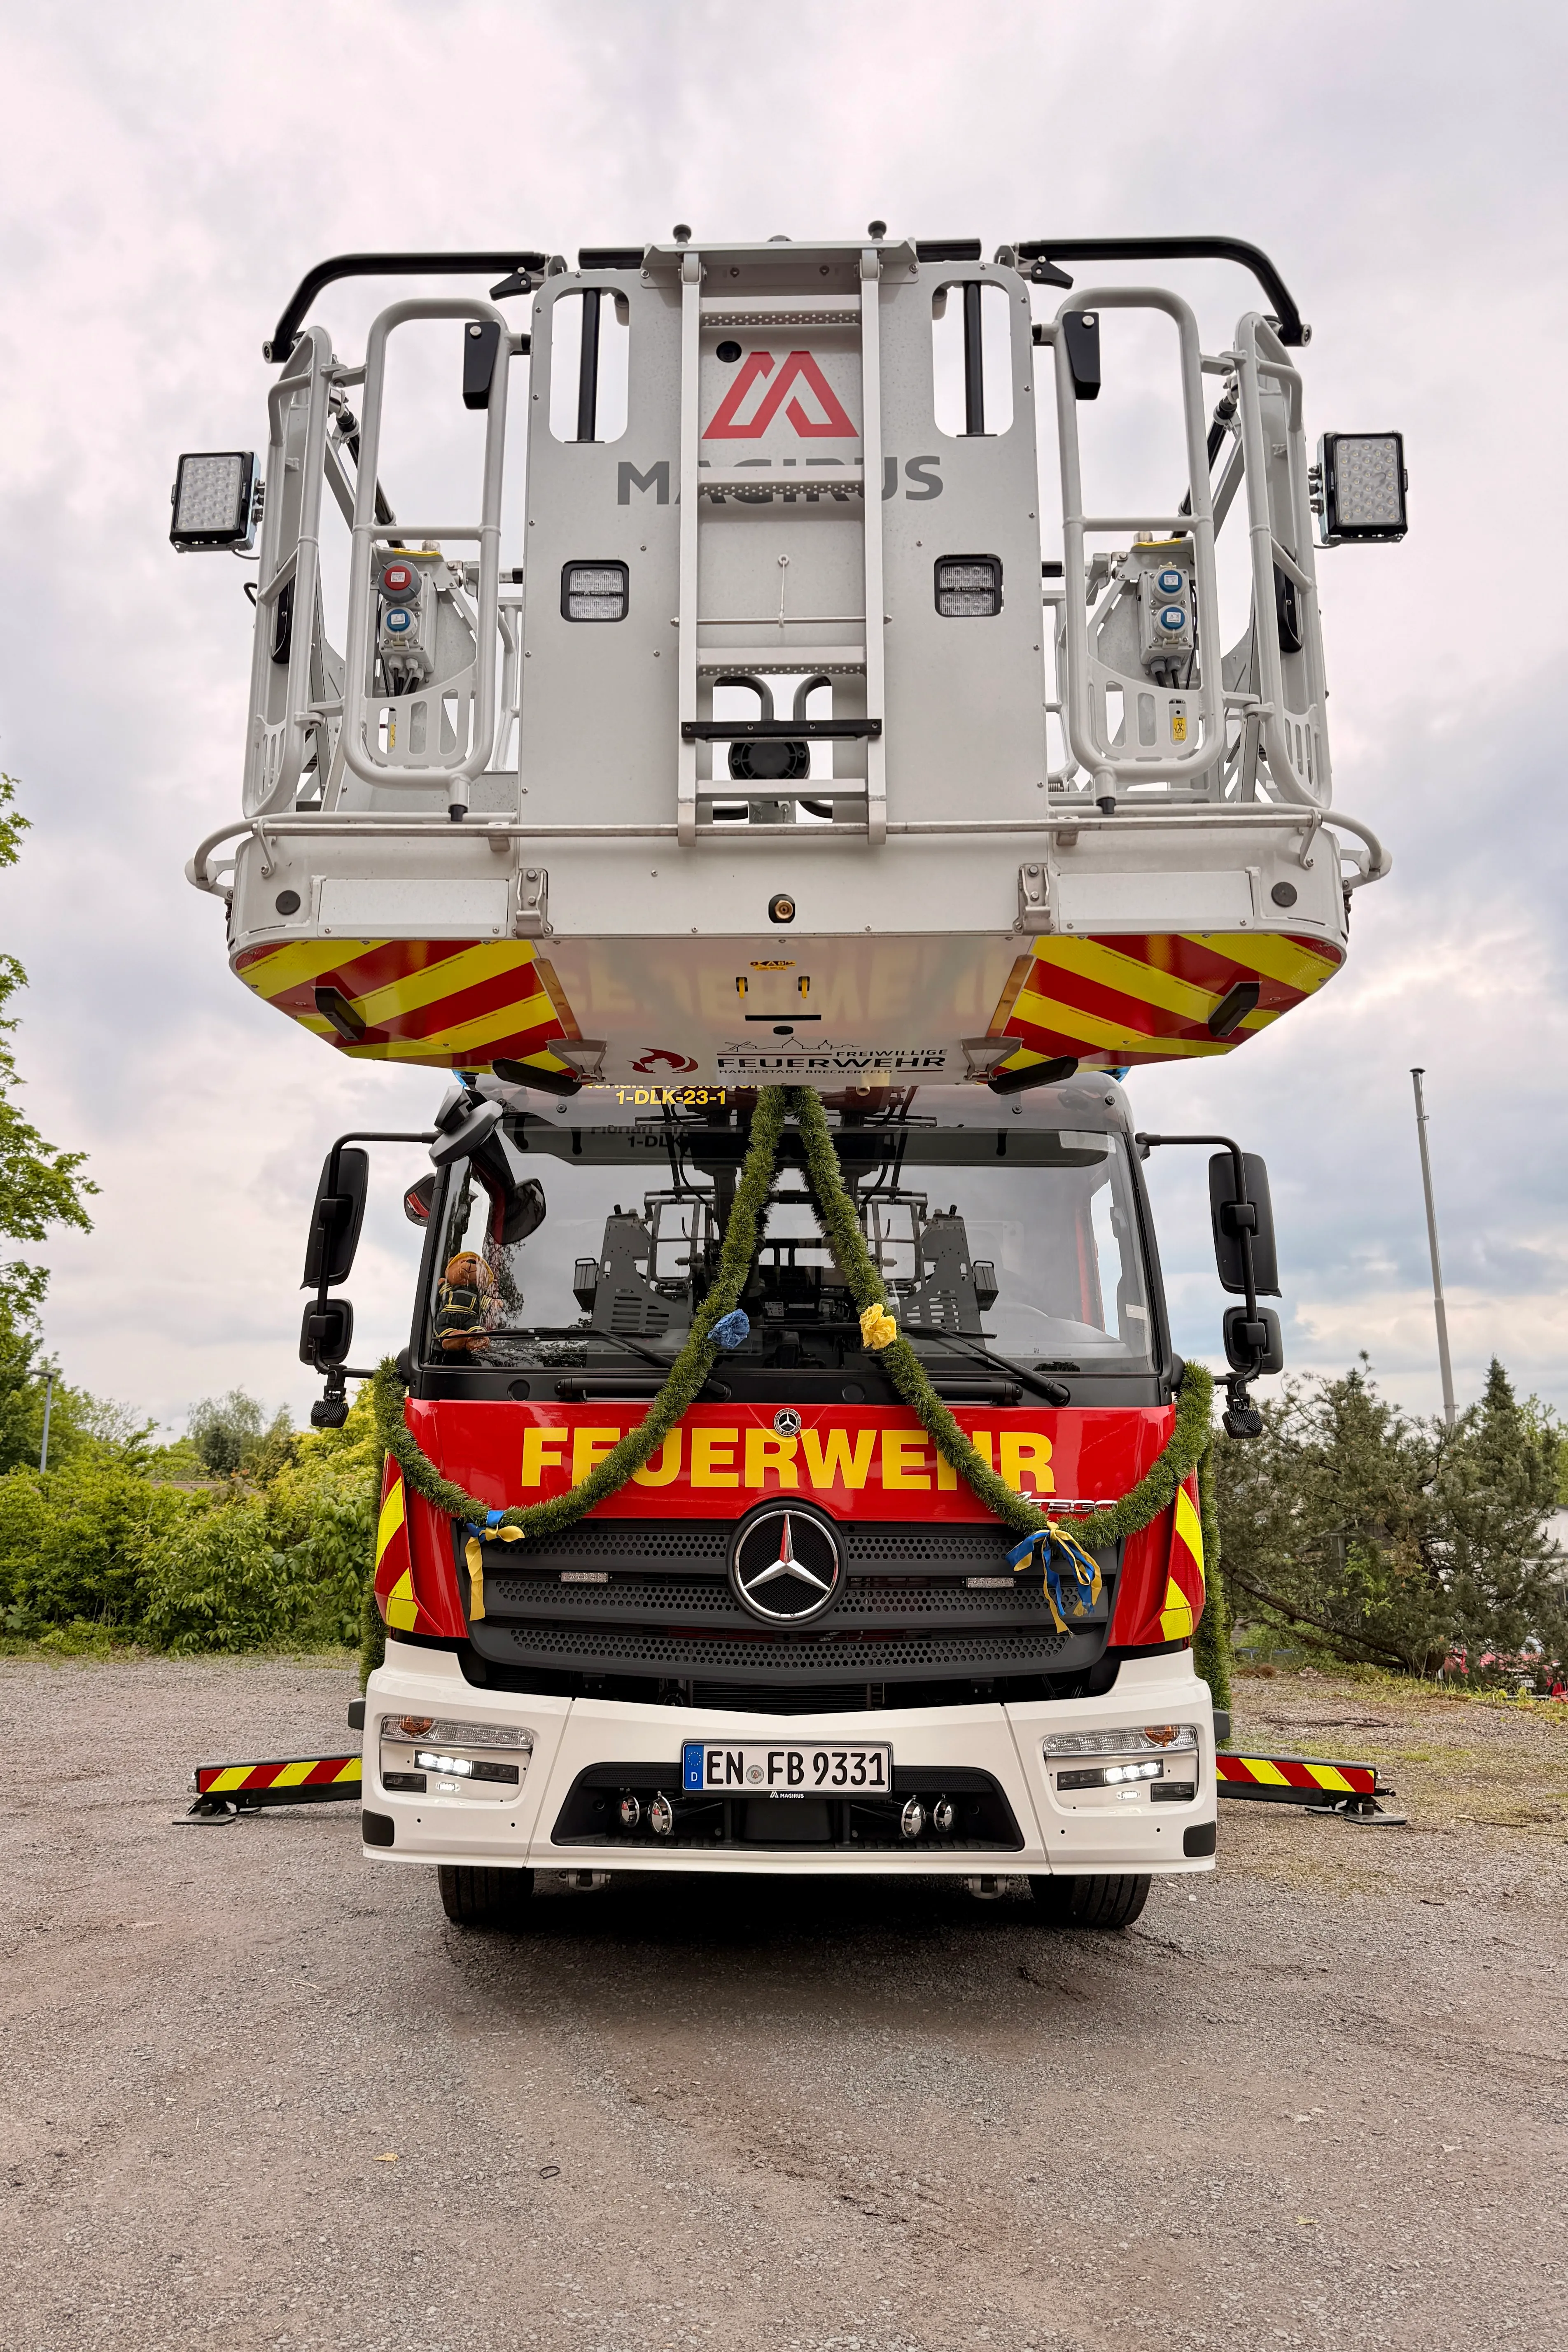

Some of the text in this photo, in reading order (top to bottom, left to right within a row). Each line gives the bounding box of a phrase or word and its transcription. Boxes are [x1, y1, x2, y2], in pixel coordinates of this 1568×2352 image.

[717, 1057, 945, 1068] FEUERWEHR
[616, 1090, 726, 1105] 1-DLK-23-1
[1020, 1491, 1118, 1514] TEGO
[691, 1772, 698, 1782] D
[707, 1751, 743, 1785] EN
[767, 1751, 805, 1785] FB
[813, 1752, 885, 1786] 9331
